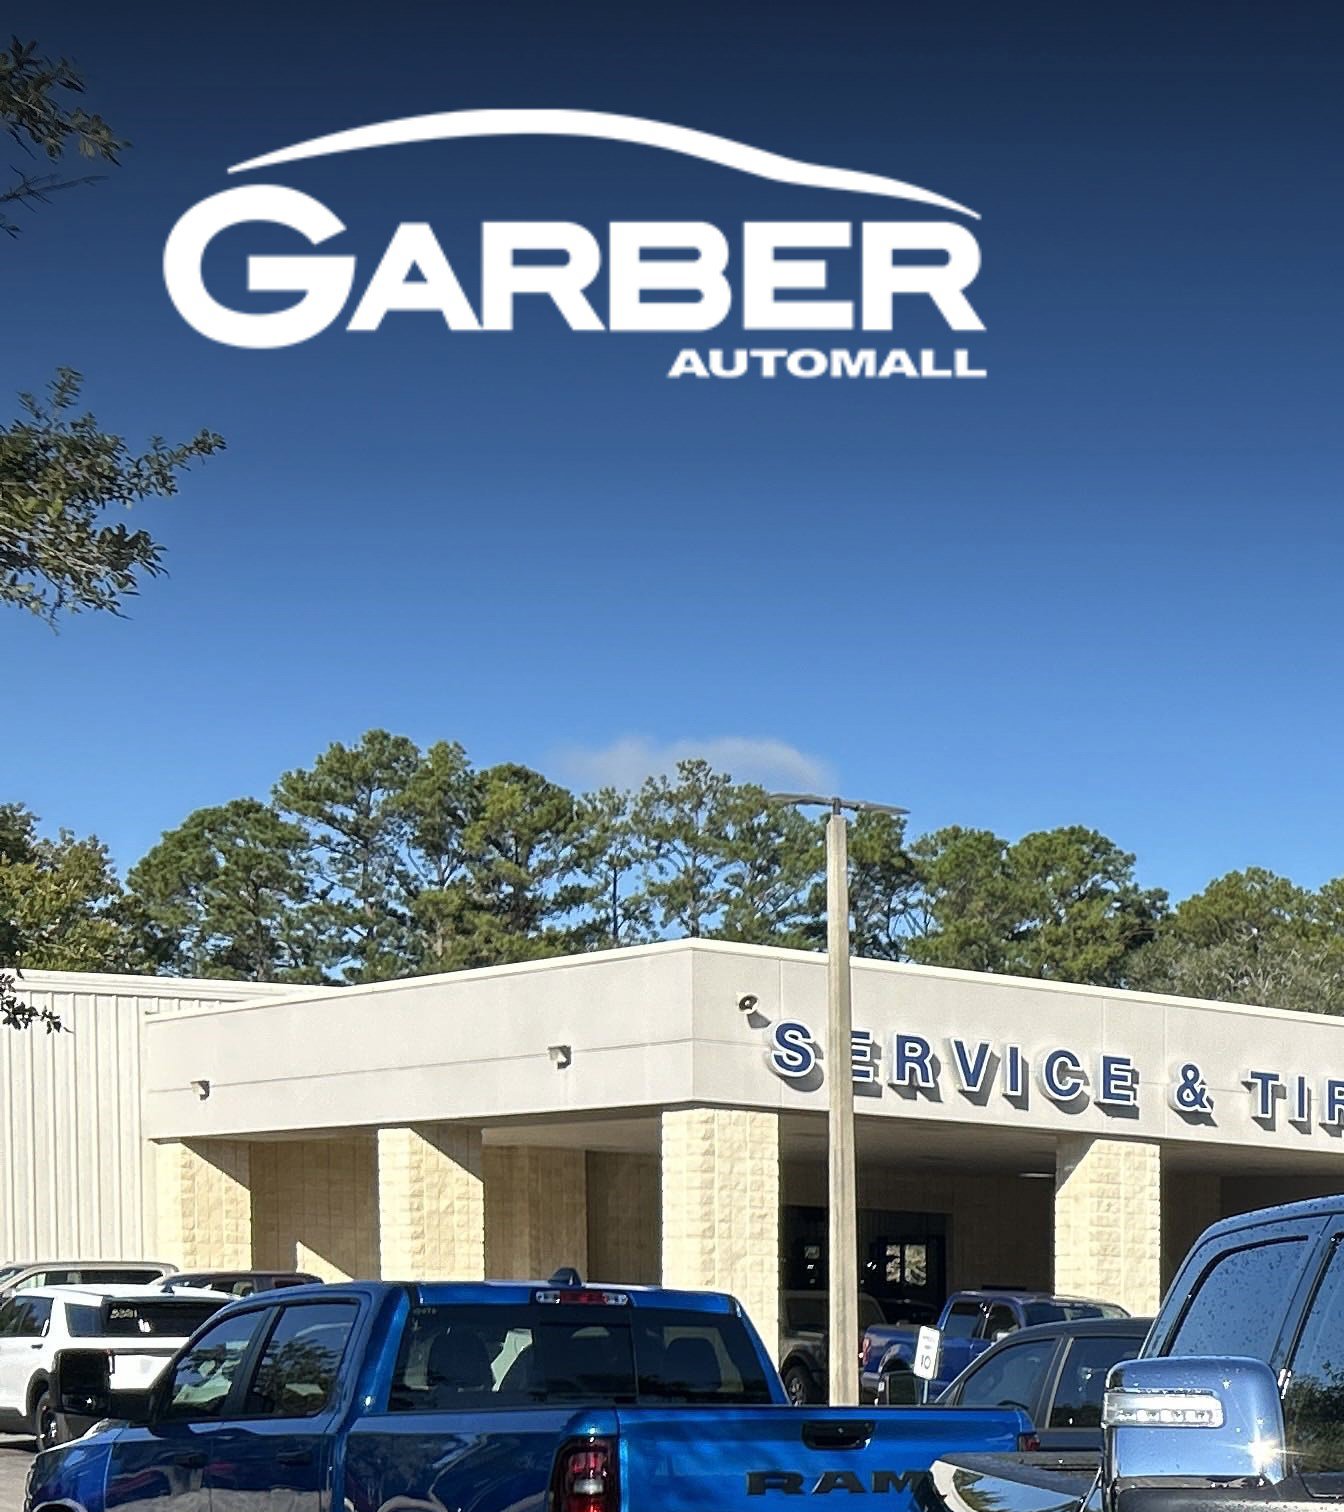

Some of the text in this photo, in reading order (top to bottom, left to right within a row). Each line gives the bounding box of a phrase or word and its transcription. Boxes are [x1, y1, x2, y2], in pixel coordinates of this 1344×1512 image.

[772, 1021, 1135, 1106] SERVICE
[1174, 1060, 1208, 1113] &
[746, 1470, 931, 1496] RAM
